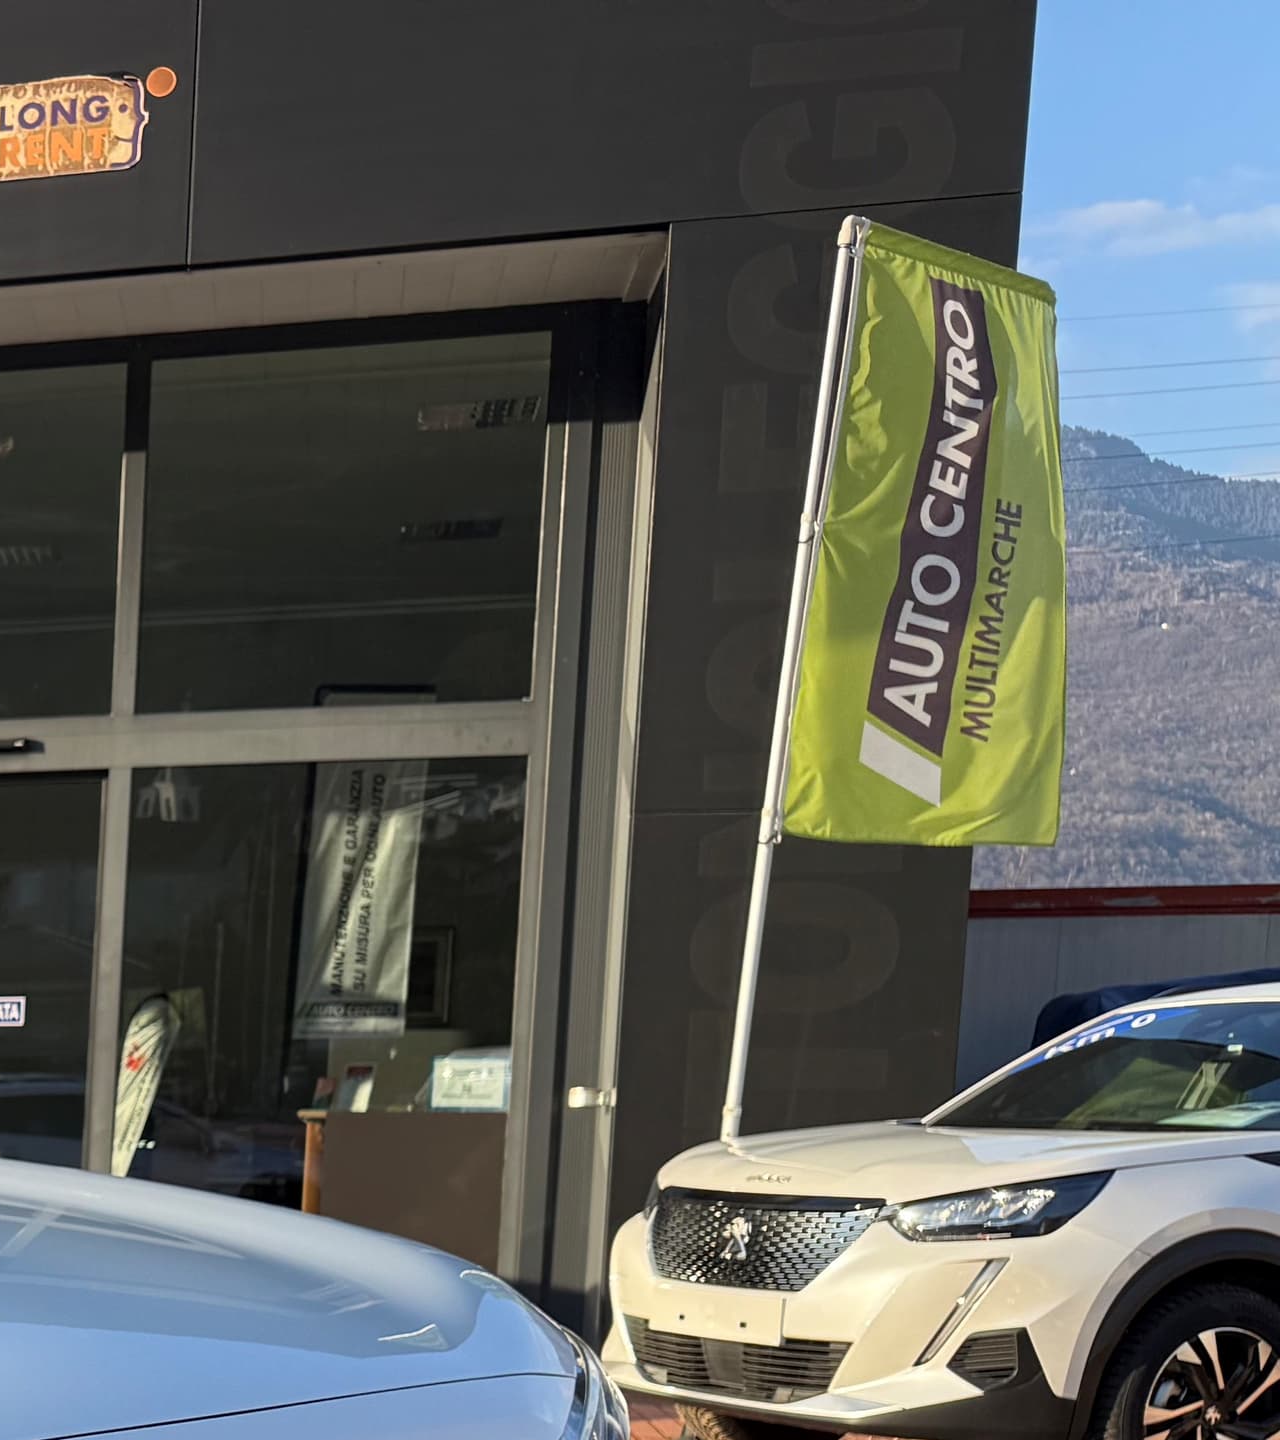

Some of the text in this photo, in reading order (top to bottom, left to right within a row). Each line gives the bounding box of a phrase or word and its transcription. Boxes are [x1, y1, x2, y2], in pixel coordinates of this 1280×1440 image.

[0, 95, 110, 132] LONG
[883, 299, 984, 729] AUTO CENTRO
[959, 498, 1023, 743] MULTIMARCHE
[368, 773, 386, 820] AUTO
[361, 868, 375, 899] PER
[354, 903, 371, 966] MISURA
[351, 971, 367, 992] SU
